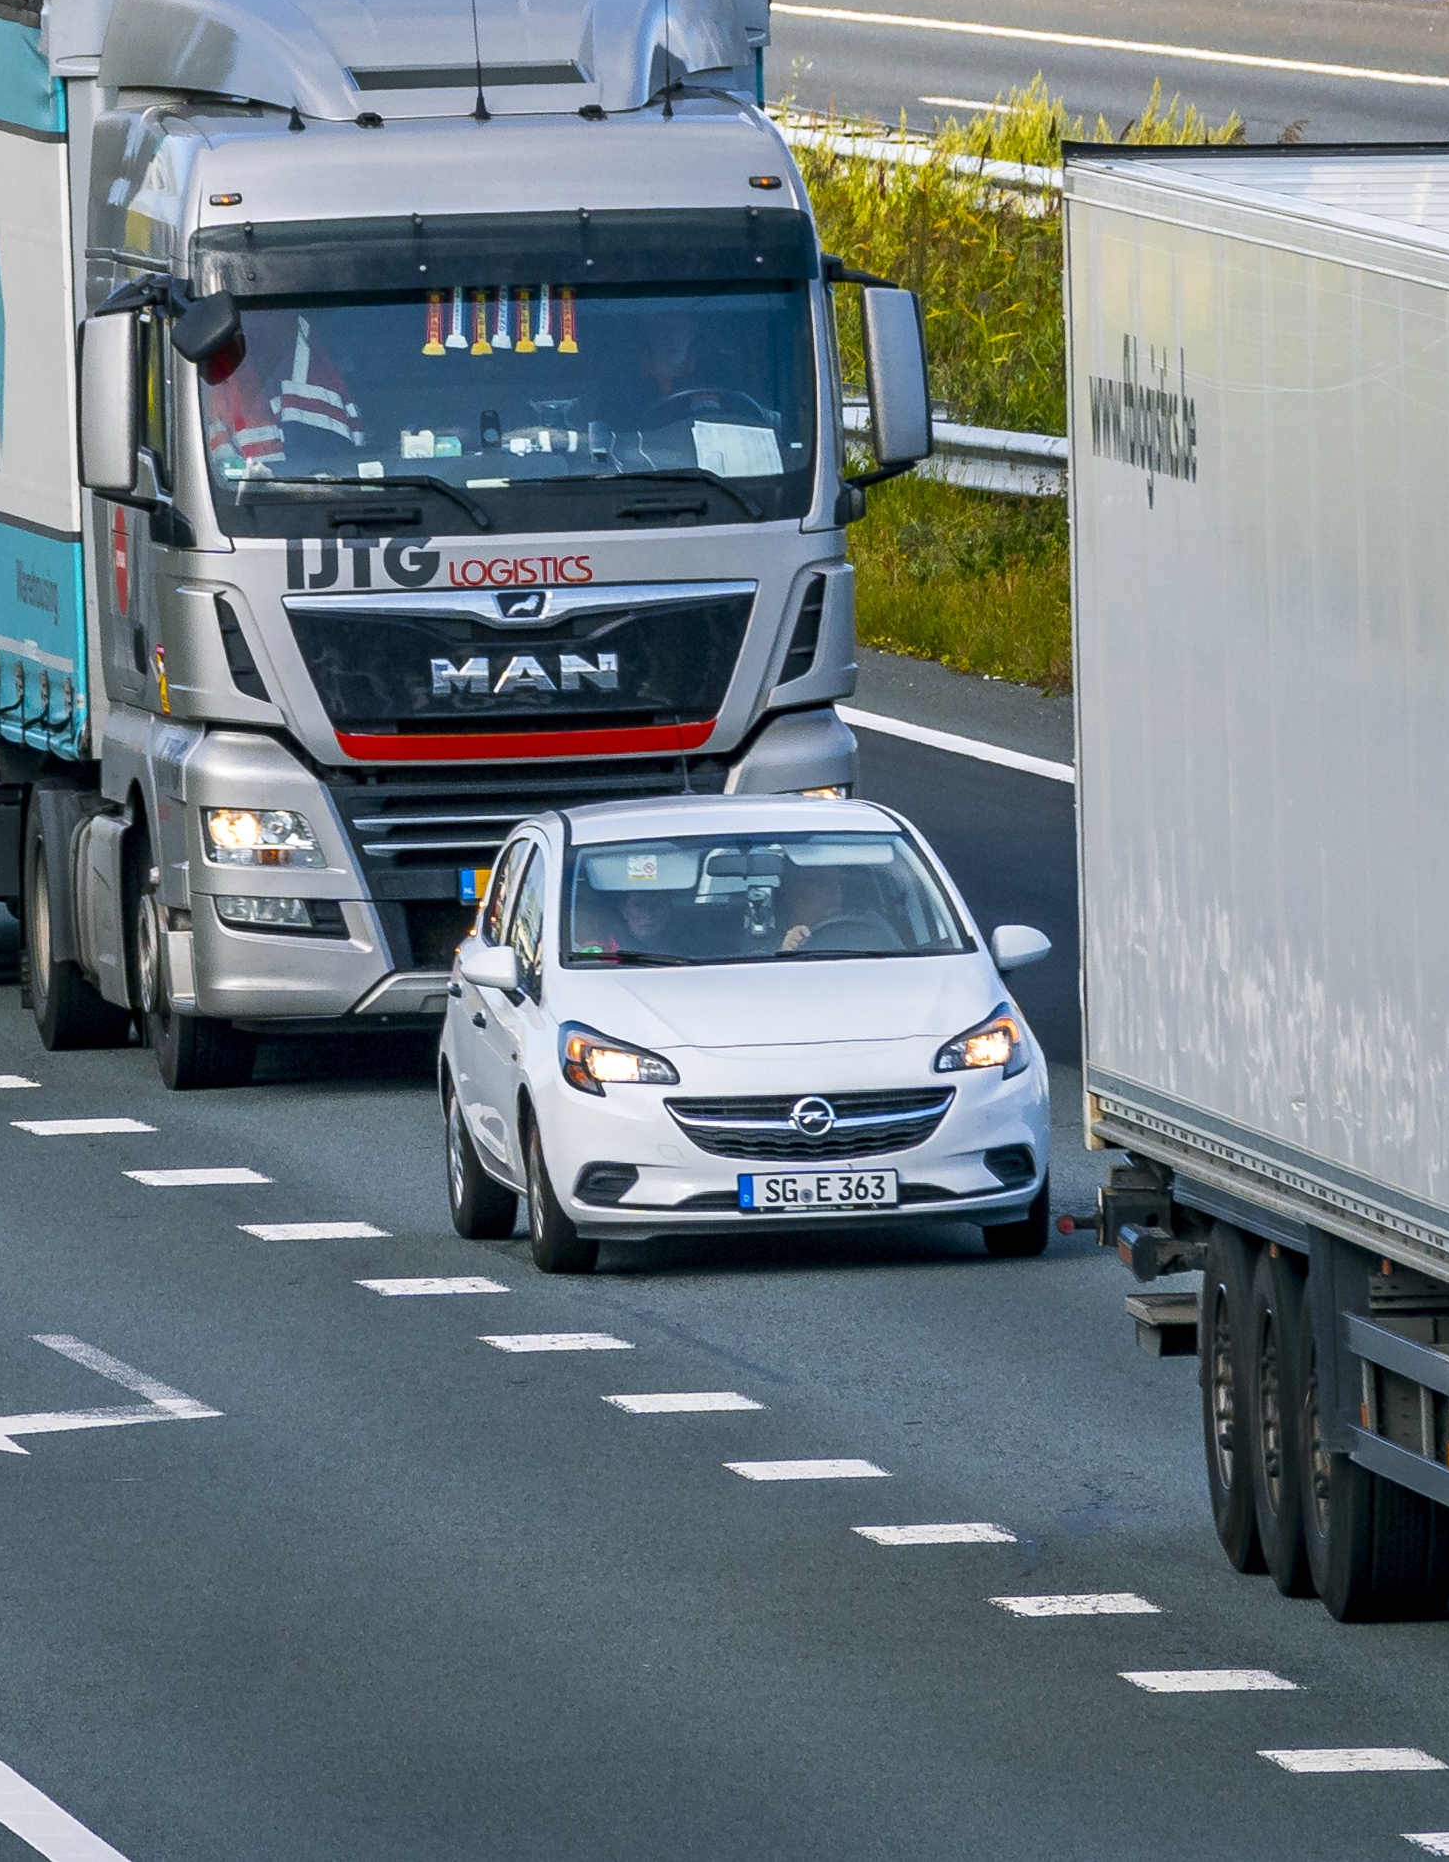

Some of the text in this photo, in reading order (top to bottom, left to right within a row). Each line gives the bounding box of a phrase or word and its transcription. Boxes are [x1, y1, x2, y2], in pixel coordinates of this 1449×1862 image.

[449, 554, 594, 587] LOGISTICS
[430, 652, 620, 695] MAN
[765, 1178, 799, 1203] SG
[817, 1176, 833, 1202] E
[838, 1175, 886, 1201] 363
